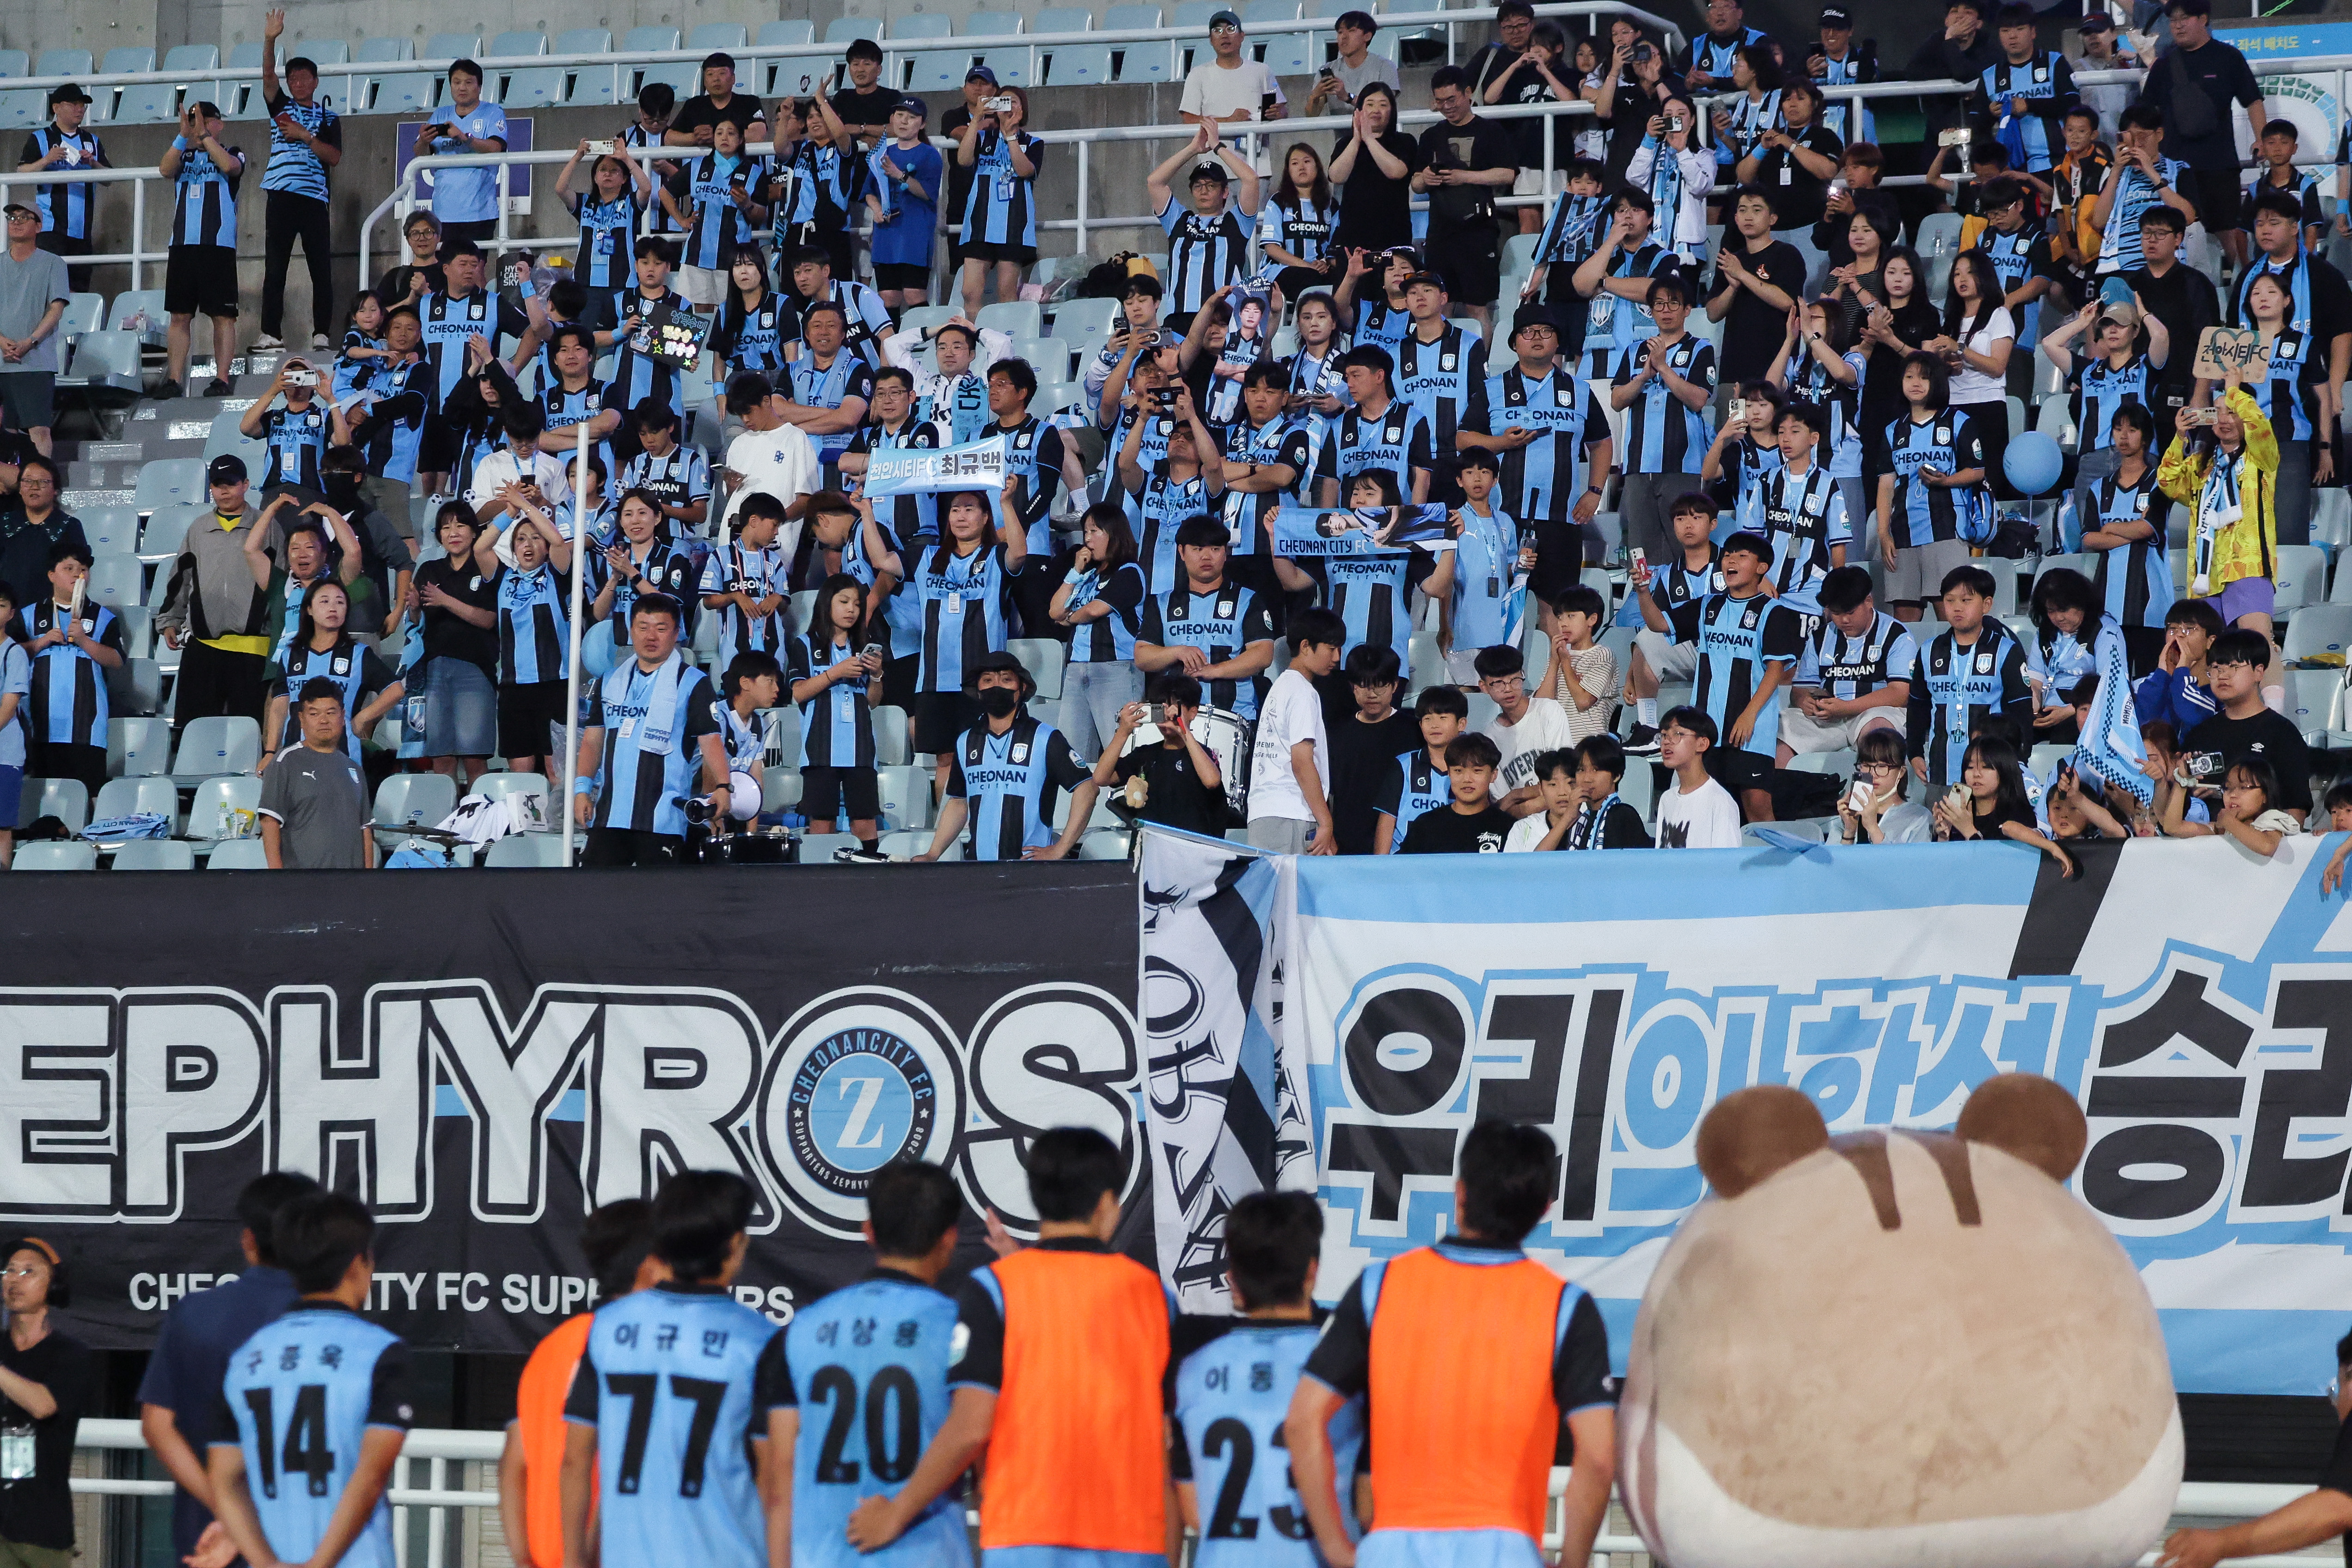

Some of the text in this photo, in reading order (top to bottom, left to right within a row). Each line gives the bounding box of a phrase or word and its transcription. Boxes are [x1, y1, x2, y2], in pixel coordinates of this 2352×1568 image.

[428, 324, 484, 335] CHEONAN
[1404, 377, 1457, 394] CHONAN
[1210, 391, 1239, 423] 18
[1505, 409, 1575, 422] CHONAN
[548, 415, 590, 428] CHEONA
[870, 455, 937, 481] 천안시티FC
[941, 451, 1002, 476] 최규백
[1894, 451, 1952, 466] CHEONAN
[1025, 494, 1042, 515] DESCENTE
[1279, 539, 1368, 554] CHEONAN CITY FC
[1332, 563, 1397, 576] CHEONAN
[1169, 623, 1233, 636] CHEONAN
[1704, 631, 1754, 649] HEONAN
[1709, 643, 1737, 652] CITY
[1825, 664, 1875, 678] CHEONAN
[606, 705, 649, 717] CHEON
[968, 769, 1027, 784] CHEONAN
[909, 1072, 932, 1100] FC
[836, 1077, 885, 1148] Z
[795, 1121, 829, 1180] SUPPORTERS
[363, 1272, 428, 1311] ITY
[436, 1272, 489, 1312] FC
[613, 1323, 729, 1359] 이규민
[810, 1364, 921, 1485] 20
[242, 1384, 336, 1499] 14
[605, 1372, 730, 1498] 77
